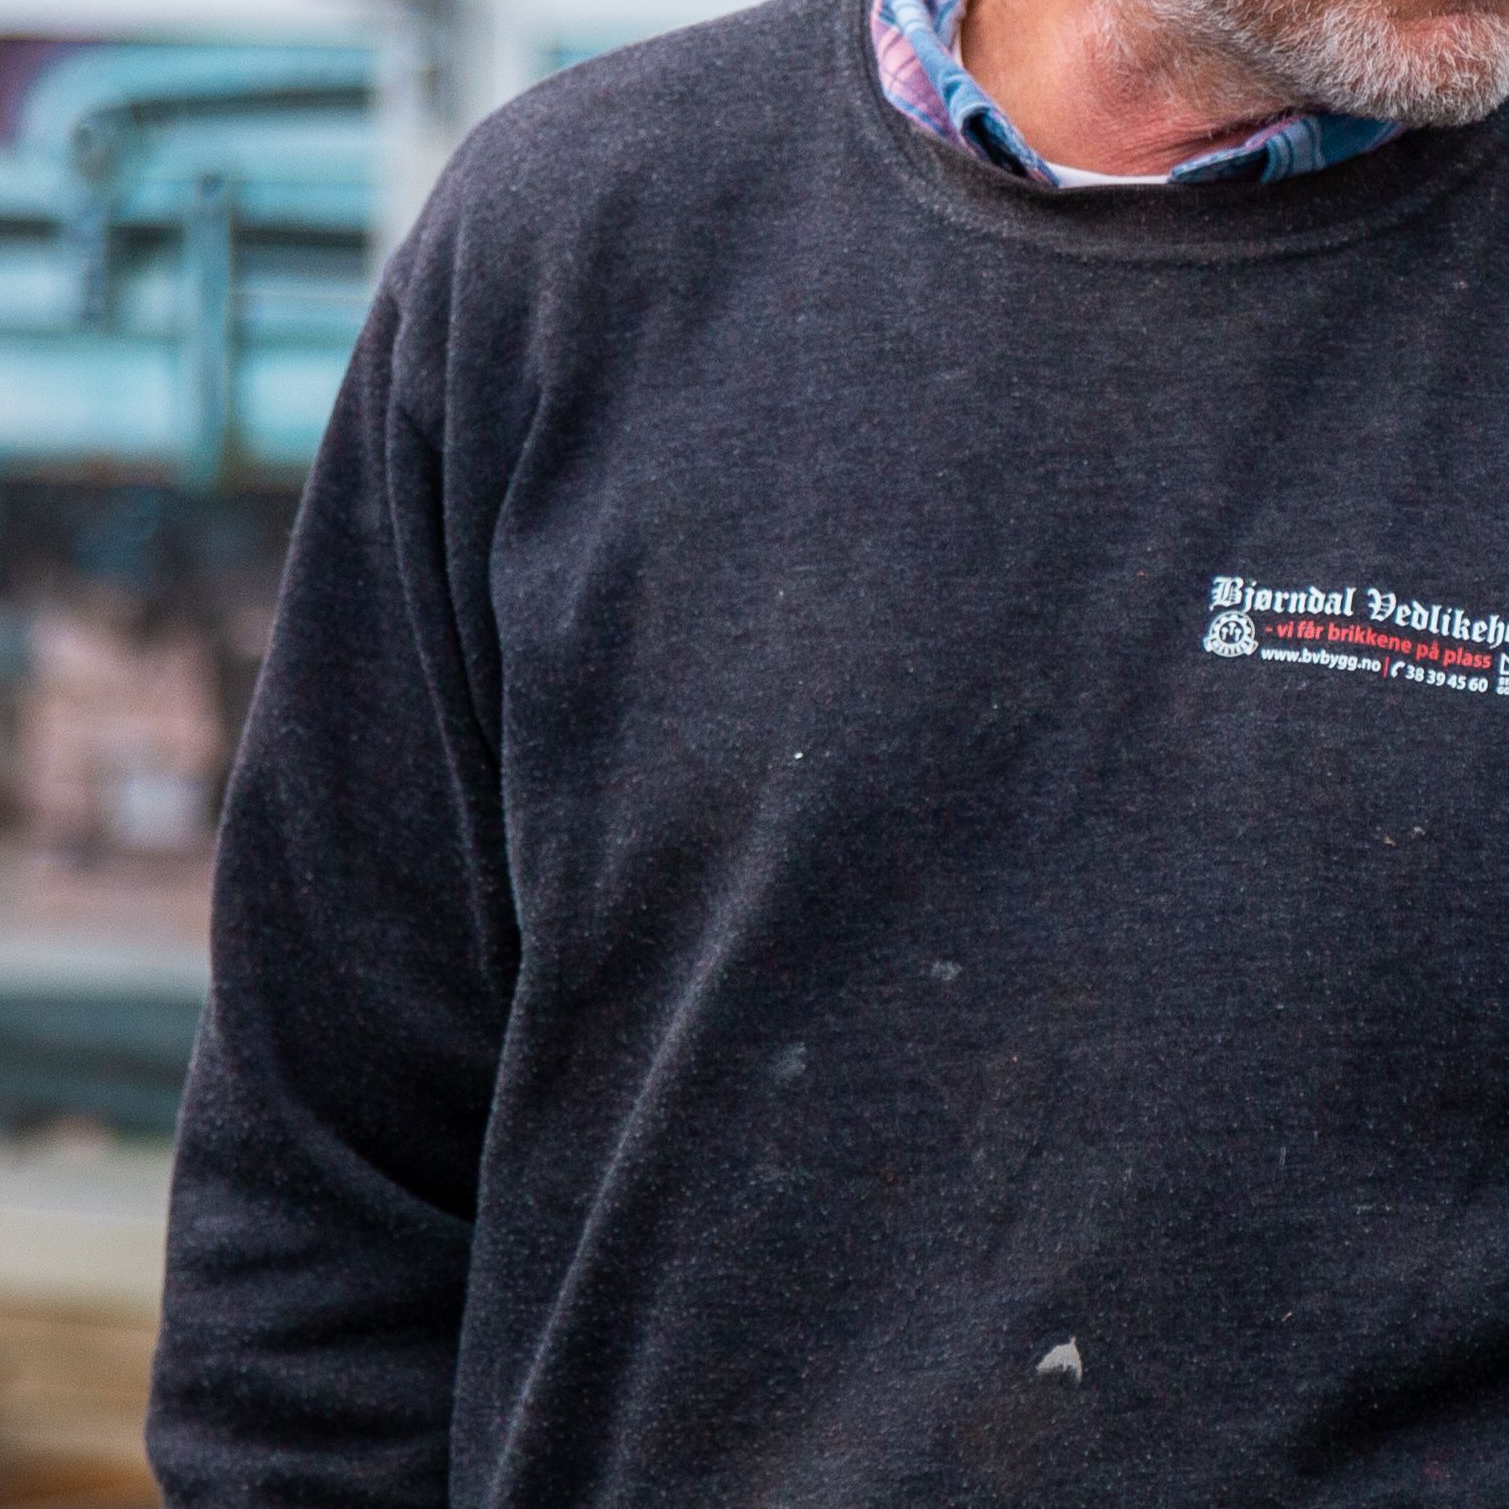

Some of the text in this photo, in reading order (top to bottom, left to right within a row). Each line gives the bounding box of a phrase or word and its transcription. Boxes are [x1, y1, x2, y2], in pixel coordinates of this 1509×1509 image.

[1209, 576, 1357, 616] Bjørndal
[1276, 621, 1294, 639] vi
[1297, 620, 1324, 640] får
[1327, 622, 1412, 654] brikkene
[1415, 639, 1441, 661] på
[1442, 646, 1493, 670] plass
[1260, 647, 1382, 672] www.bvbygg.no
[1405, 663, 1425, 683] 38
[1426, 668, 1447, 687] 39
[1447, 673, 1467, 691] 45
[1468, 676, 1489, 693] 60
